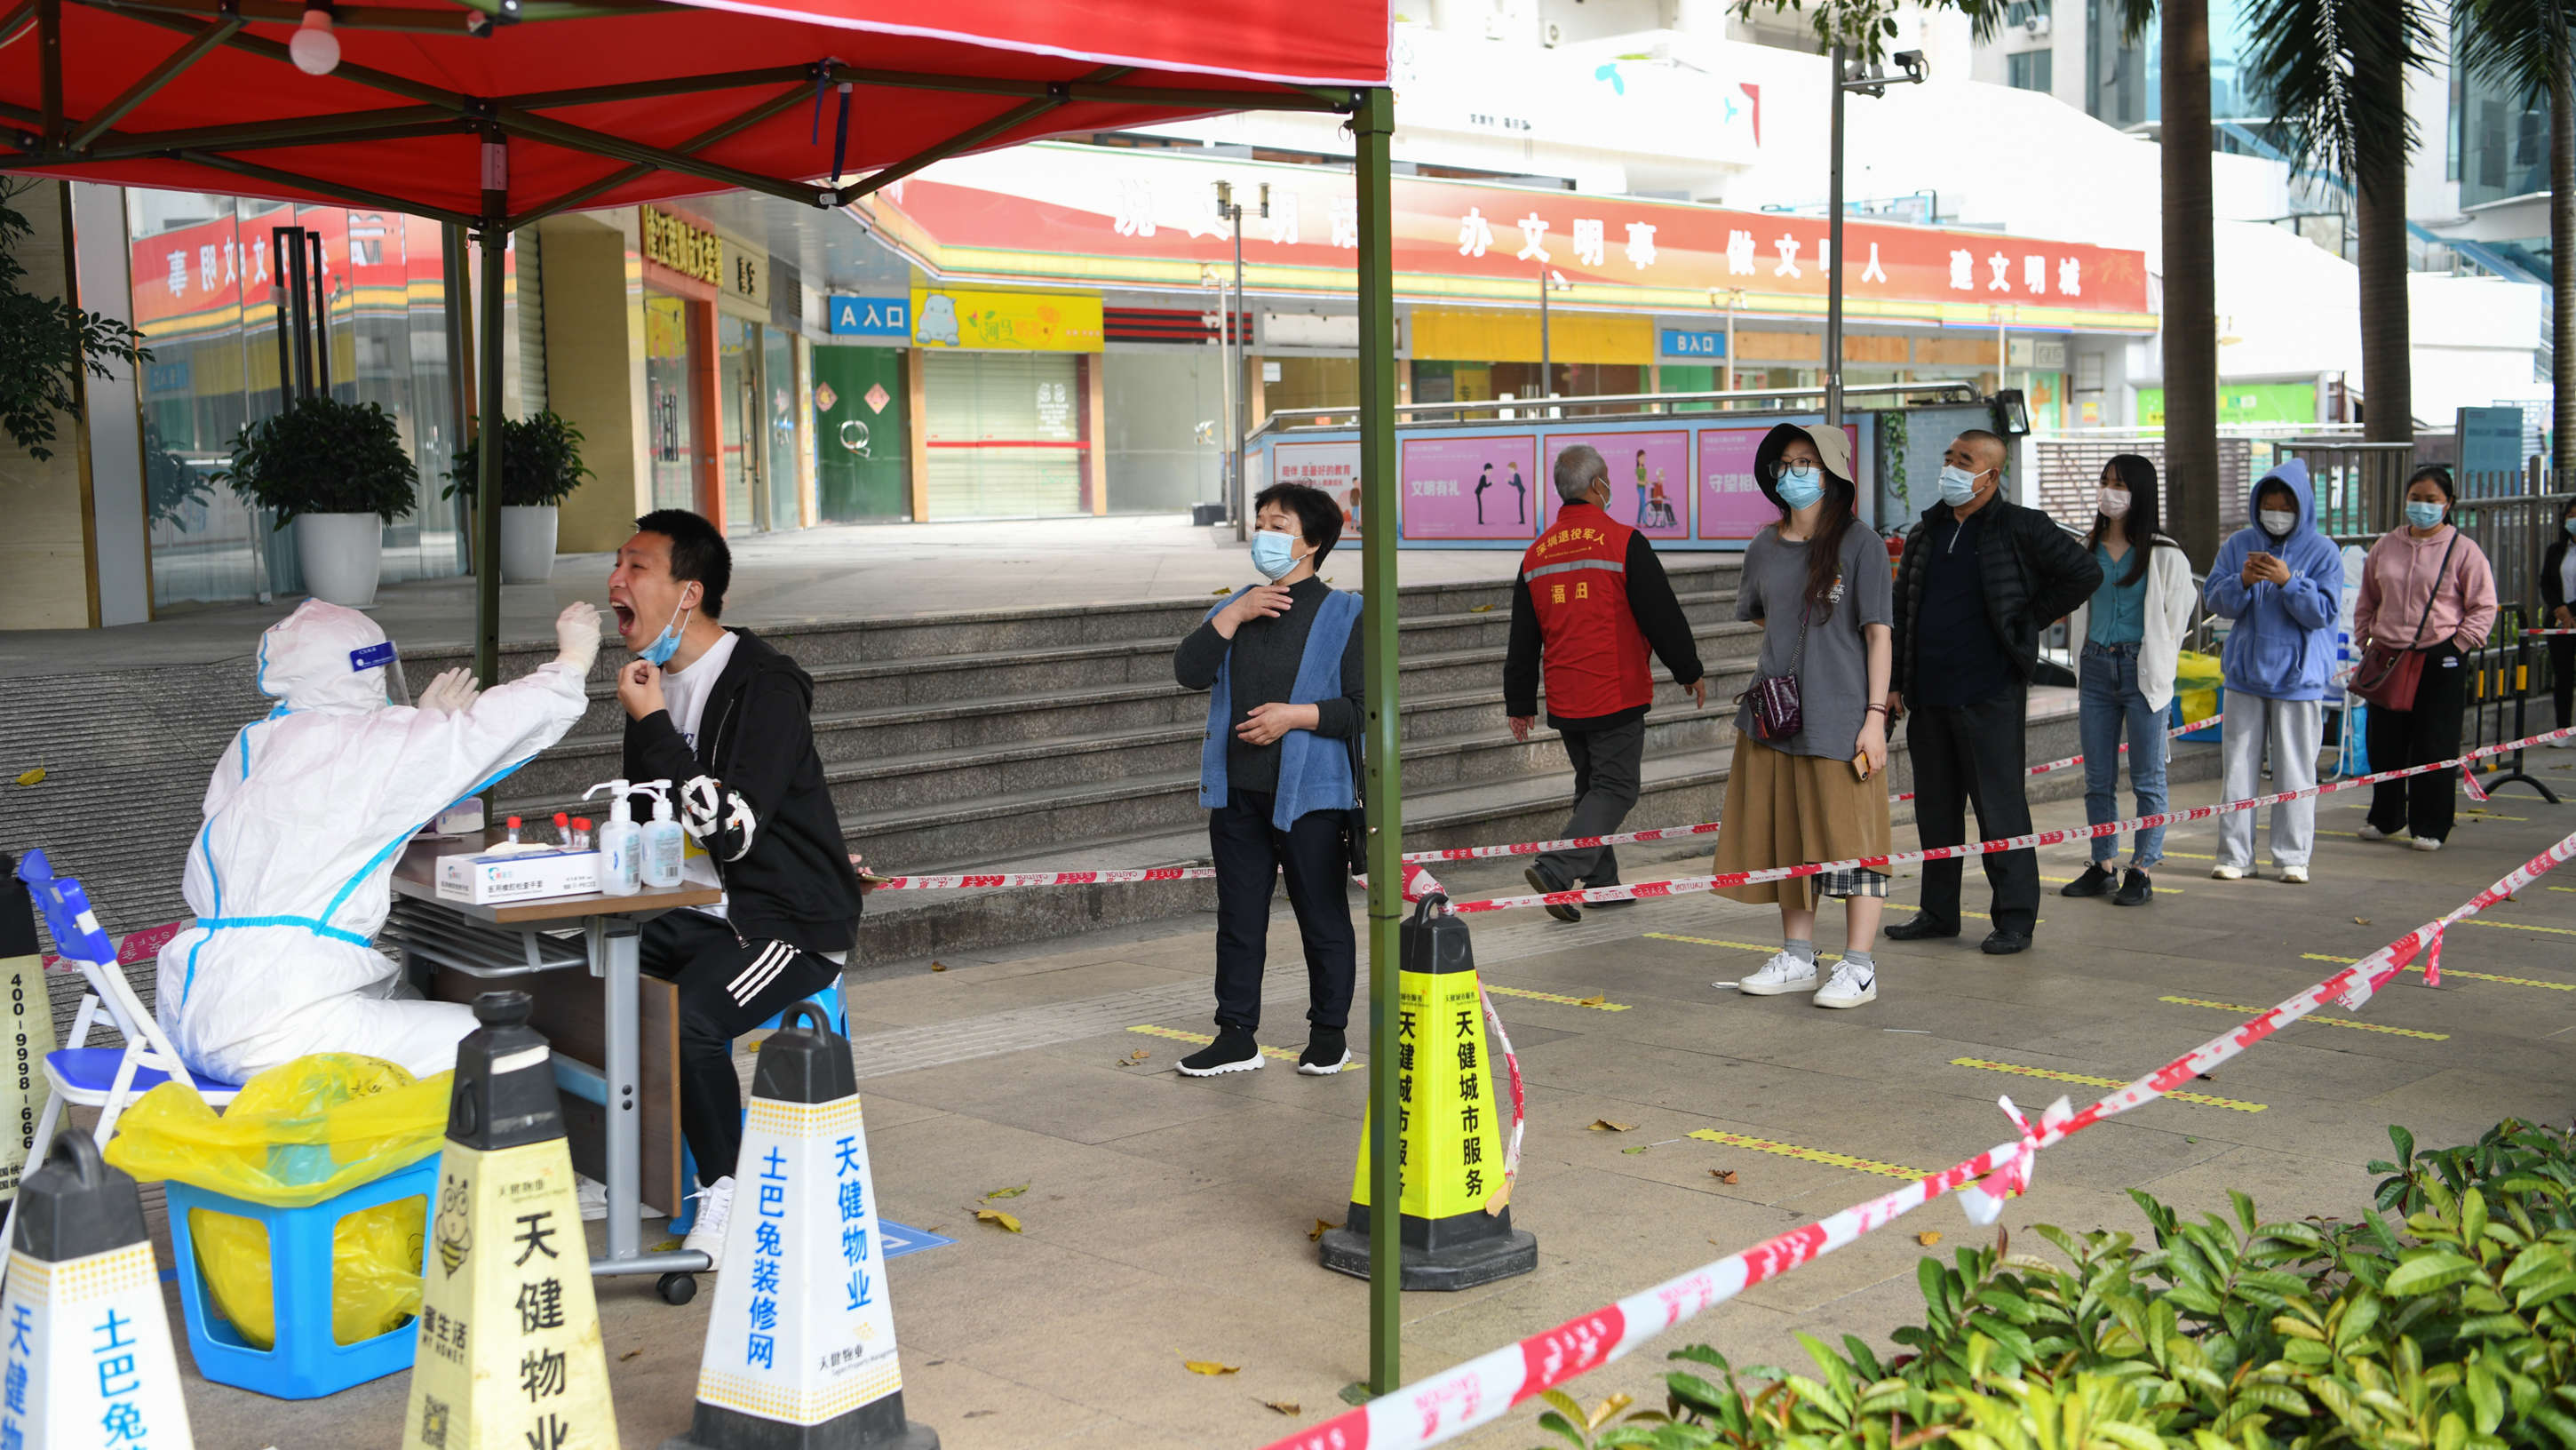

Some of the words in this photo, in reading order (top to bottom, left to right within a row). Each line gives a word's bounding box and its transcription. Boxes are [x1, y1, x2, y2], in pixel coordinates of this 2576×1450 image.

[1411, 479, 1461, 497] 文明有礼
[1536, 527, 1606, 557] 深圳退役军人
[1551, 582, 1588, 605] 福田
[10, 974, 34, 1151] 400-9998-666
[1456, 1010, 1483, 1198] 天健城市服务
[746, 1146, 789, 1371] 土巴兔装修网
[835, 1135, 872, 1312] 天健物业
[92, 1308, 147, 1450] 土巴兔
